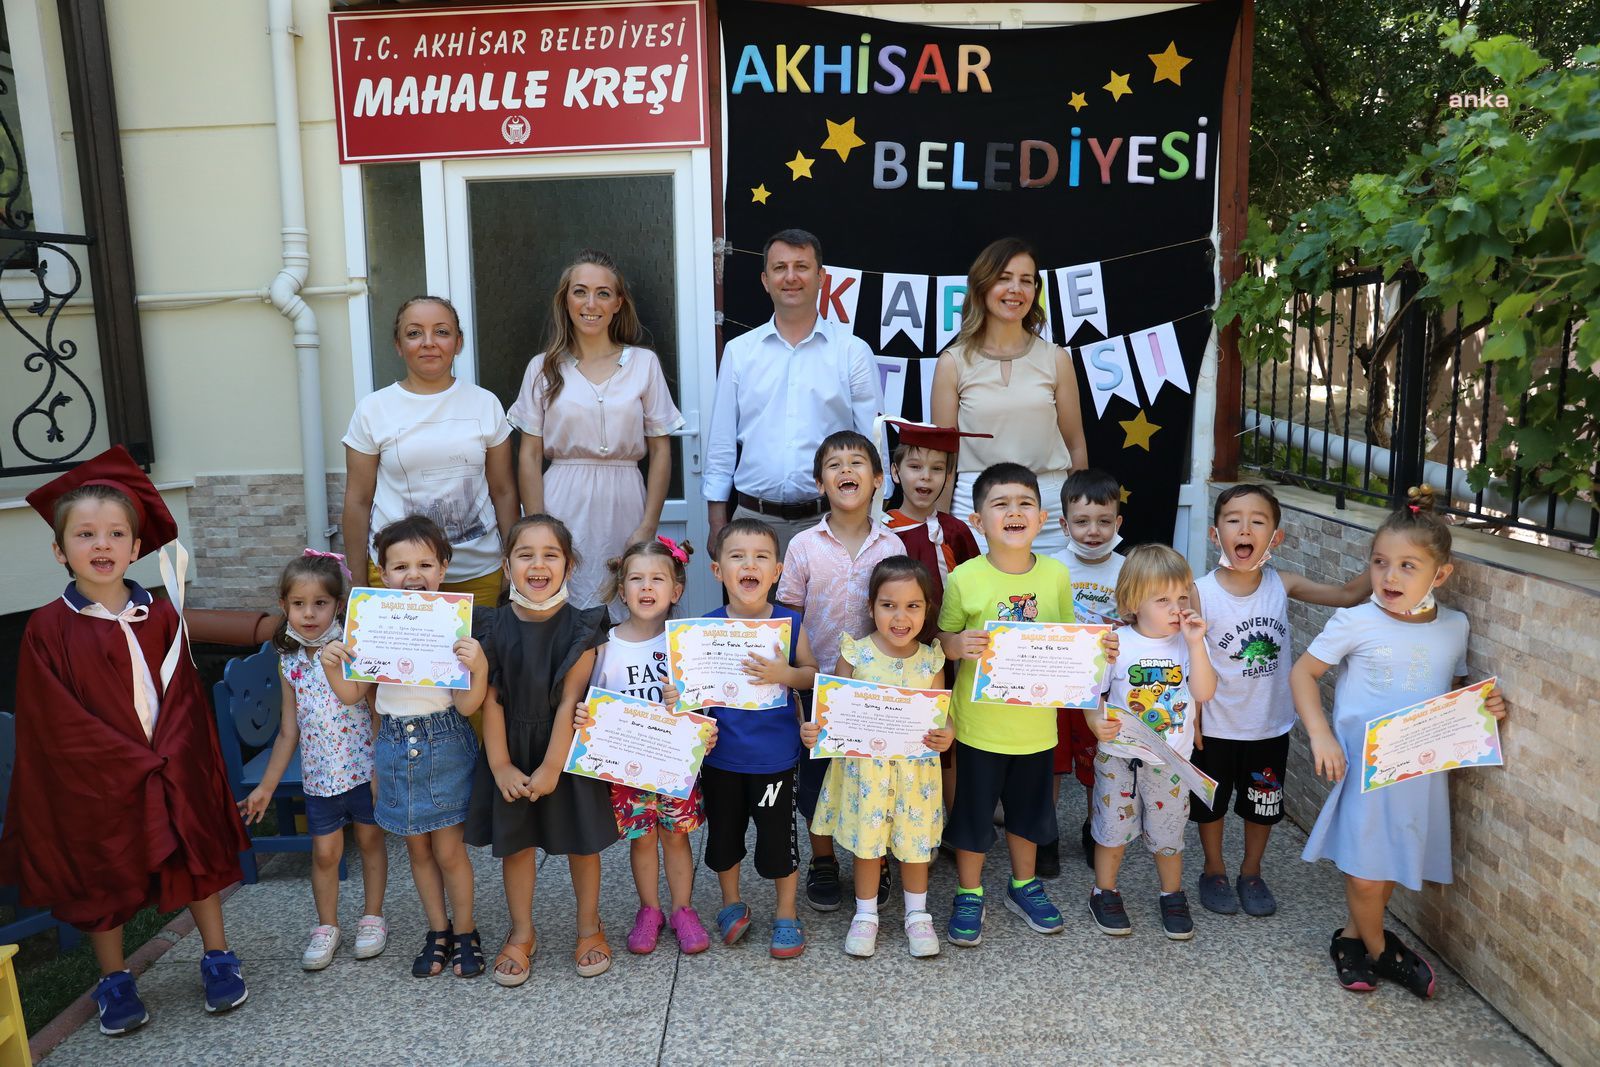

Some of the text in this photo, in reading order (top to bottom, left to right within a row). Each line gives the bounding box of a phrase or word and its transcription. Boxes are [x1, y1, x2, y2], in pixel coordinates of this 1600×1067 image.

[353, 17, 687, 62] T.C. AKHİSAR BELEDİYESİ
[731, 33, 992, 94] AKHİSAR
[353, 54, 689, 118] MAHALLE KREŞİ
[873, 116, 1208, 191] BELEDİYESİ
[1075, 590, 1110, 603] friends
[1218, 616, 1287, 650] BIG ADVENTURE
[1128, 664, 1183, 686] STARS
[1139, 659, 1176, 668] BRAWL
[1242, 660, 1279, 678] FEARLESS
[1254, 803, 1280, 817] MAN
